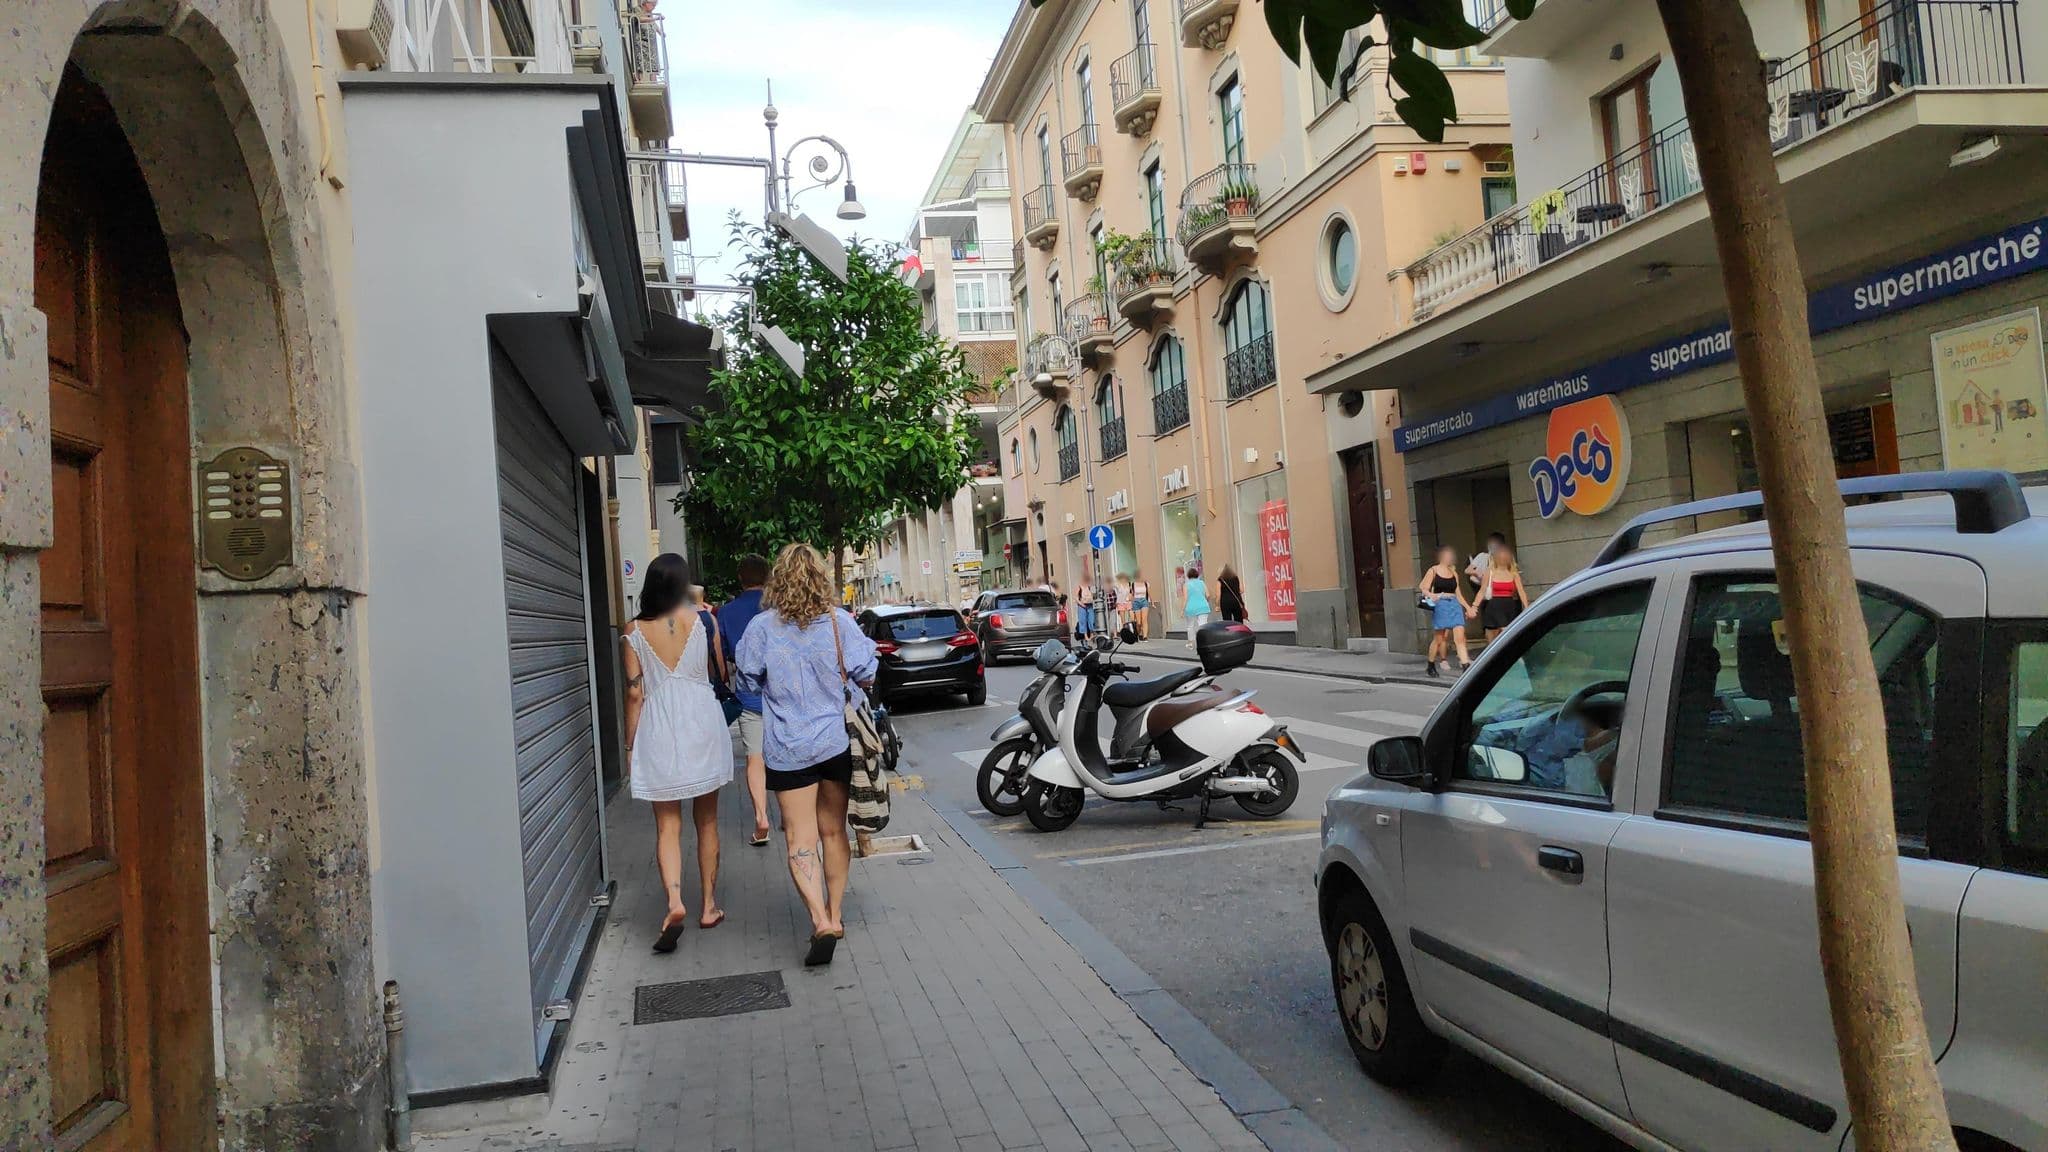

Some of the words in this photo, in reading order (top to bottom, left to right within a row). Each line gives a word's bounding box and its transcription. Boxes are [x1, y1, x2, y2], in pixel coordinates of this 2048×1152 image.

[1650, 330, 1732, 371] supermar
[1516, 374, 1589, 411] warenhaus
[1405, 410, 1473, 444] supermercato
[1269, 512, 1289, 533] SAL
[1271, 537, 1291, 557] SAL
[1274, 561, 1294, 582] SAL
[1276, 589, 1296, 607] SAL
